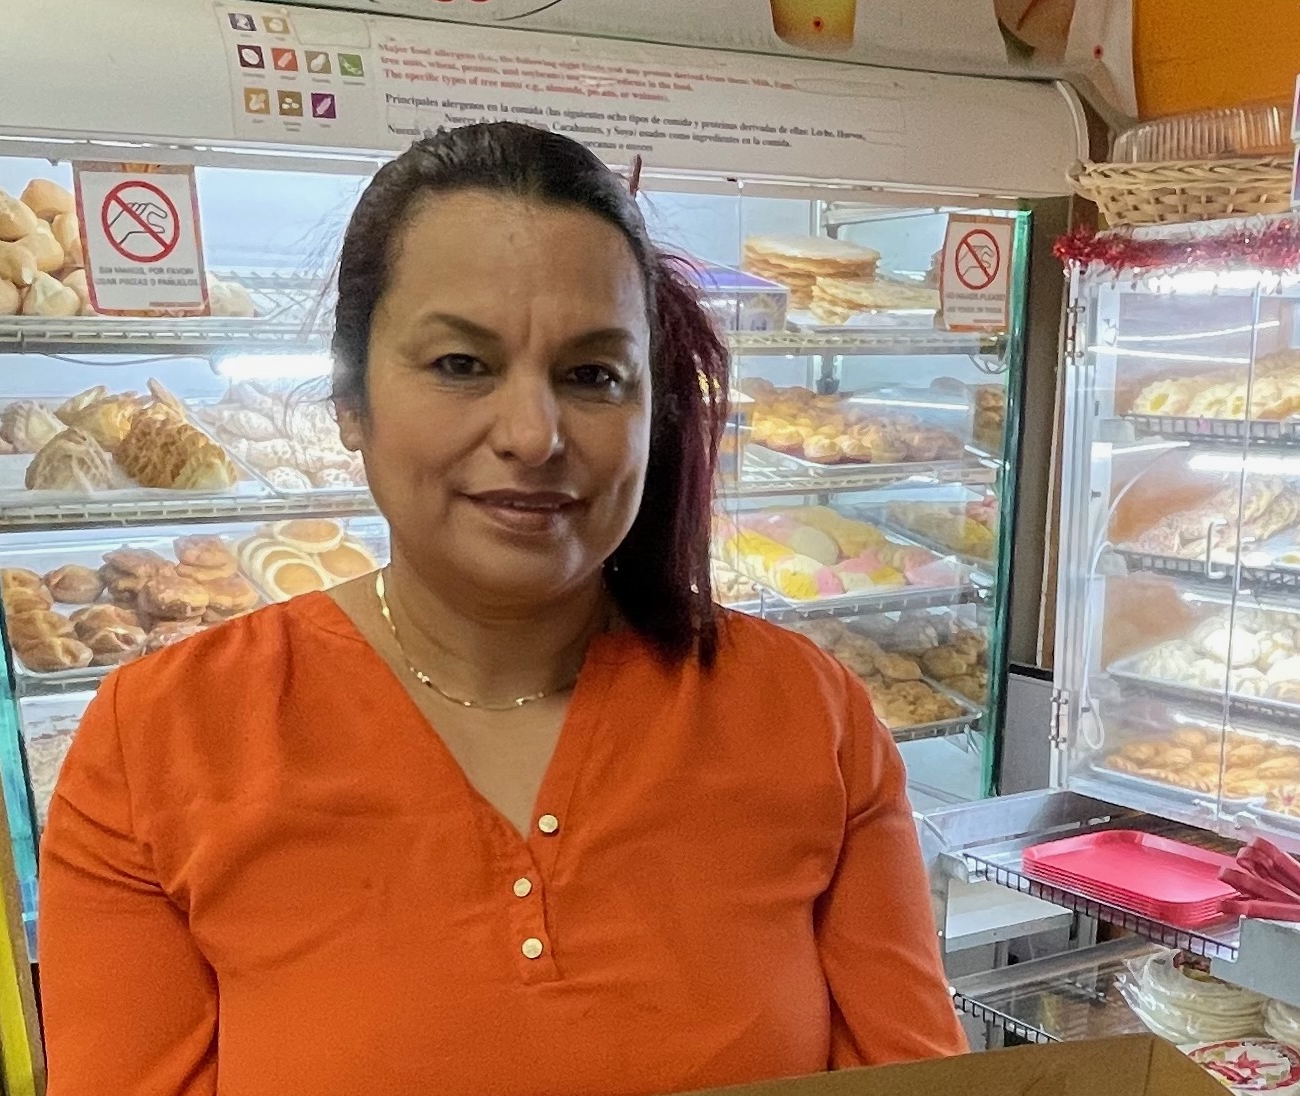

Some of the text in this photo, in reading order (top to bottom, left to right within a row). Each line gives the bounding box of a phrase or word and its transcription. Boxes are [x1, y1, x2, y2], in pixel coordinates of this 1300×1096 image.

[385, 93, 439, 107] Principales
[487, 103, 498, 112] en
[500, 103, 509, 113] la
